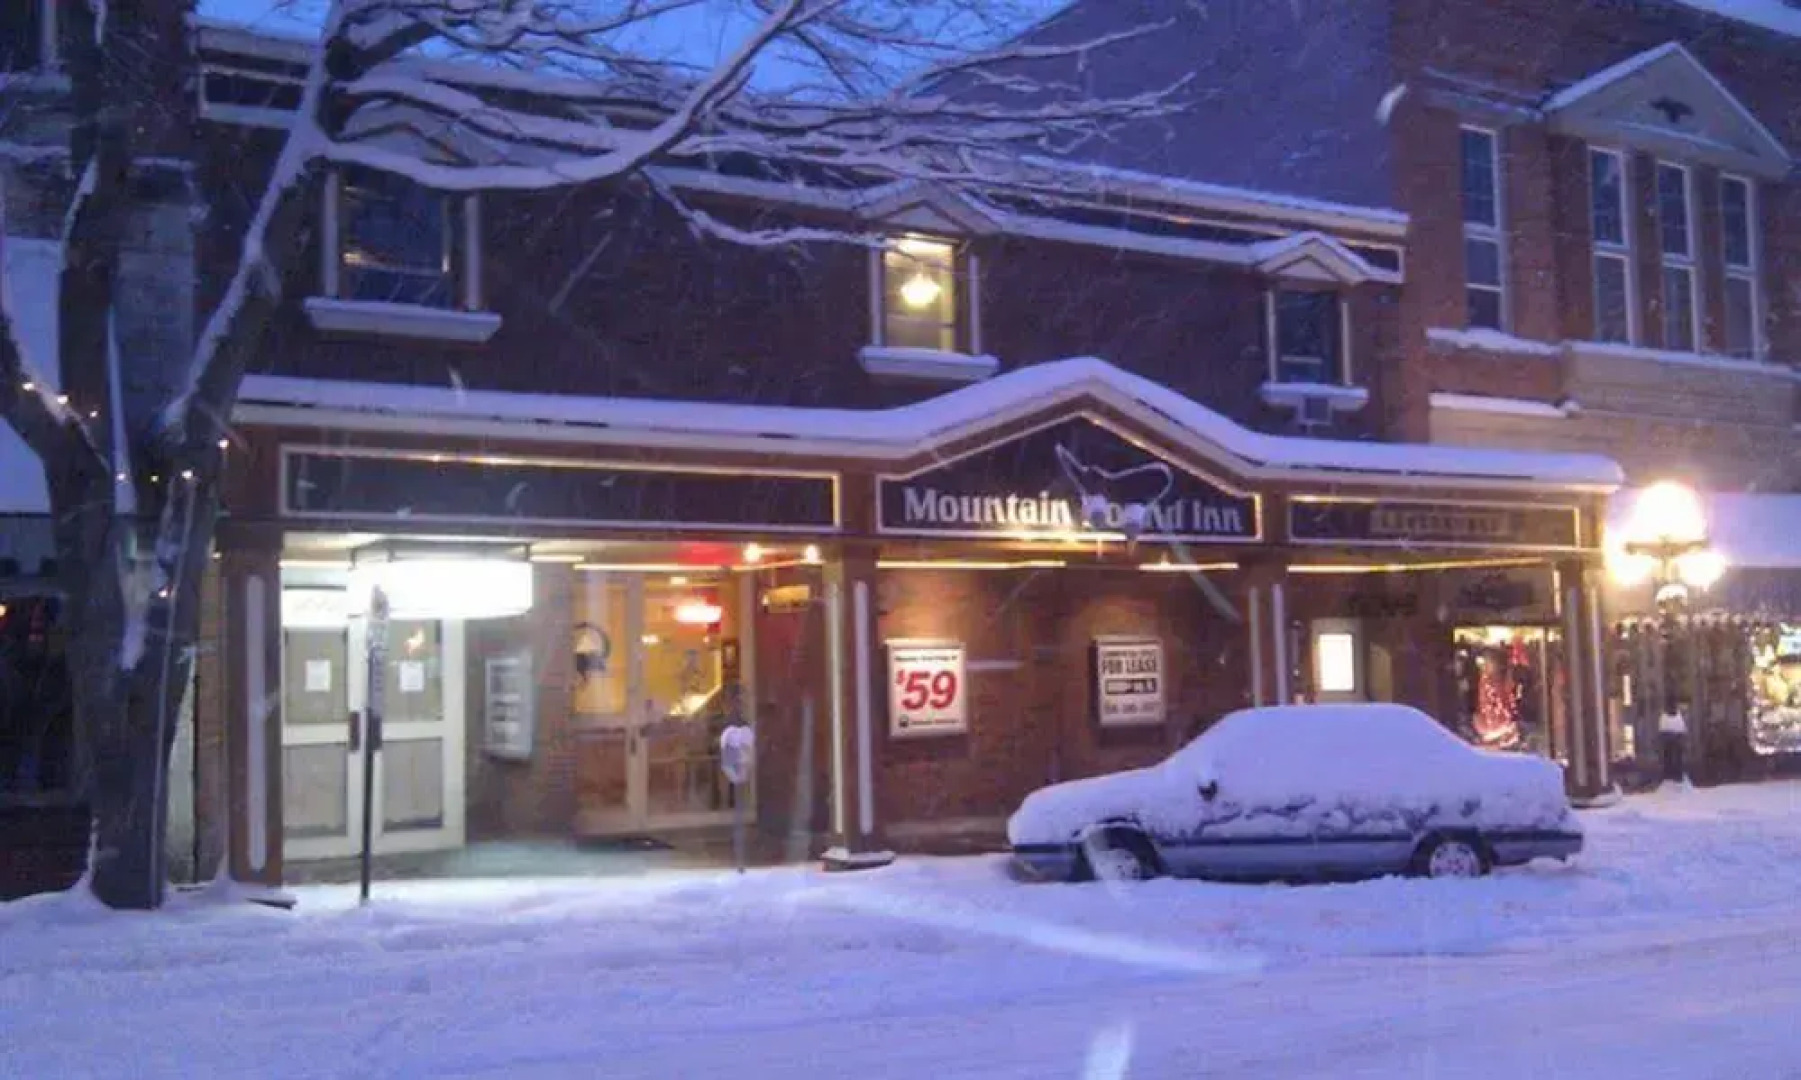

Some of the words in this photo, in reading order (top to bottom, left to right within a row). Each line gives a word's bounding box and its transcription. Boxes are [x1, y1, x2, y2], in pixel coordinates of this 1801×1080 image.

[902, 487, 1071, 525] Mountain
[1081, 494, 1182, 530] ond
[1194, 499, 1243, 532] Inn
